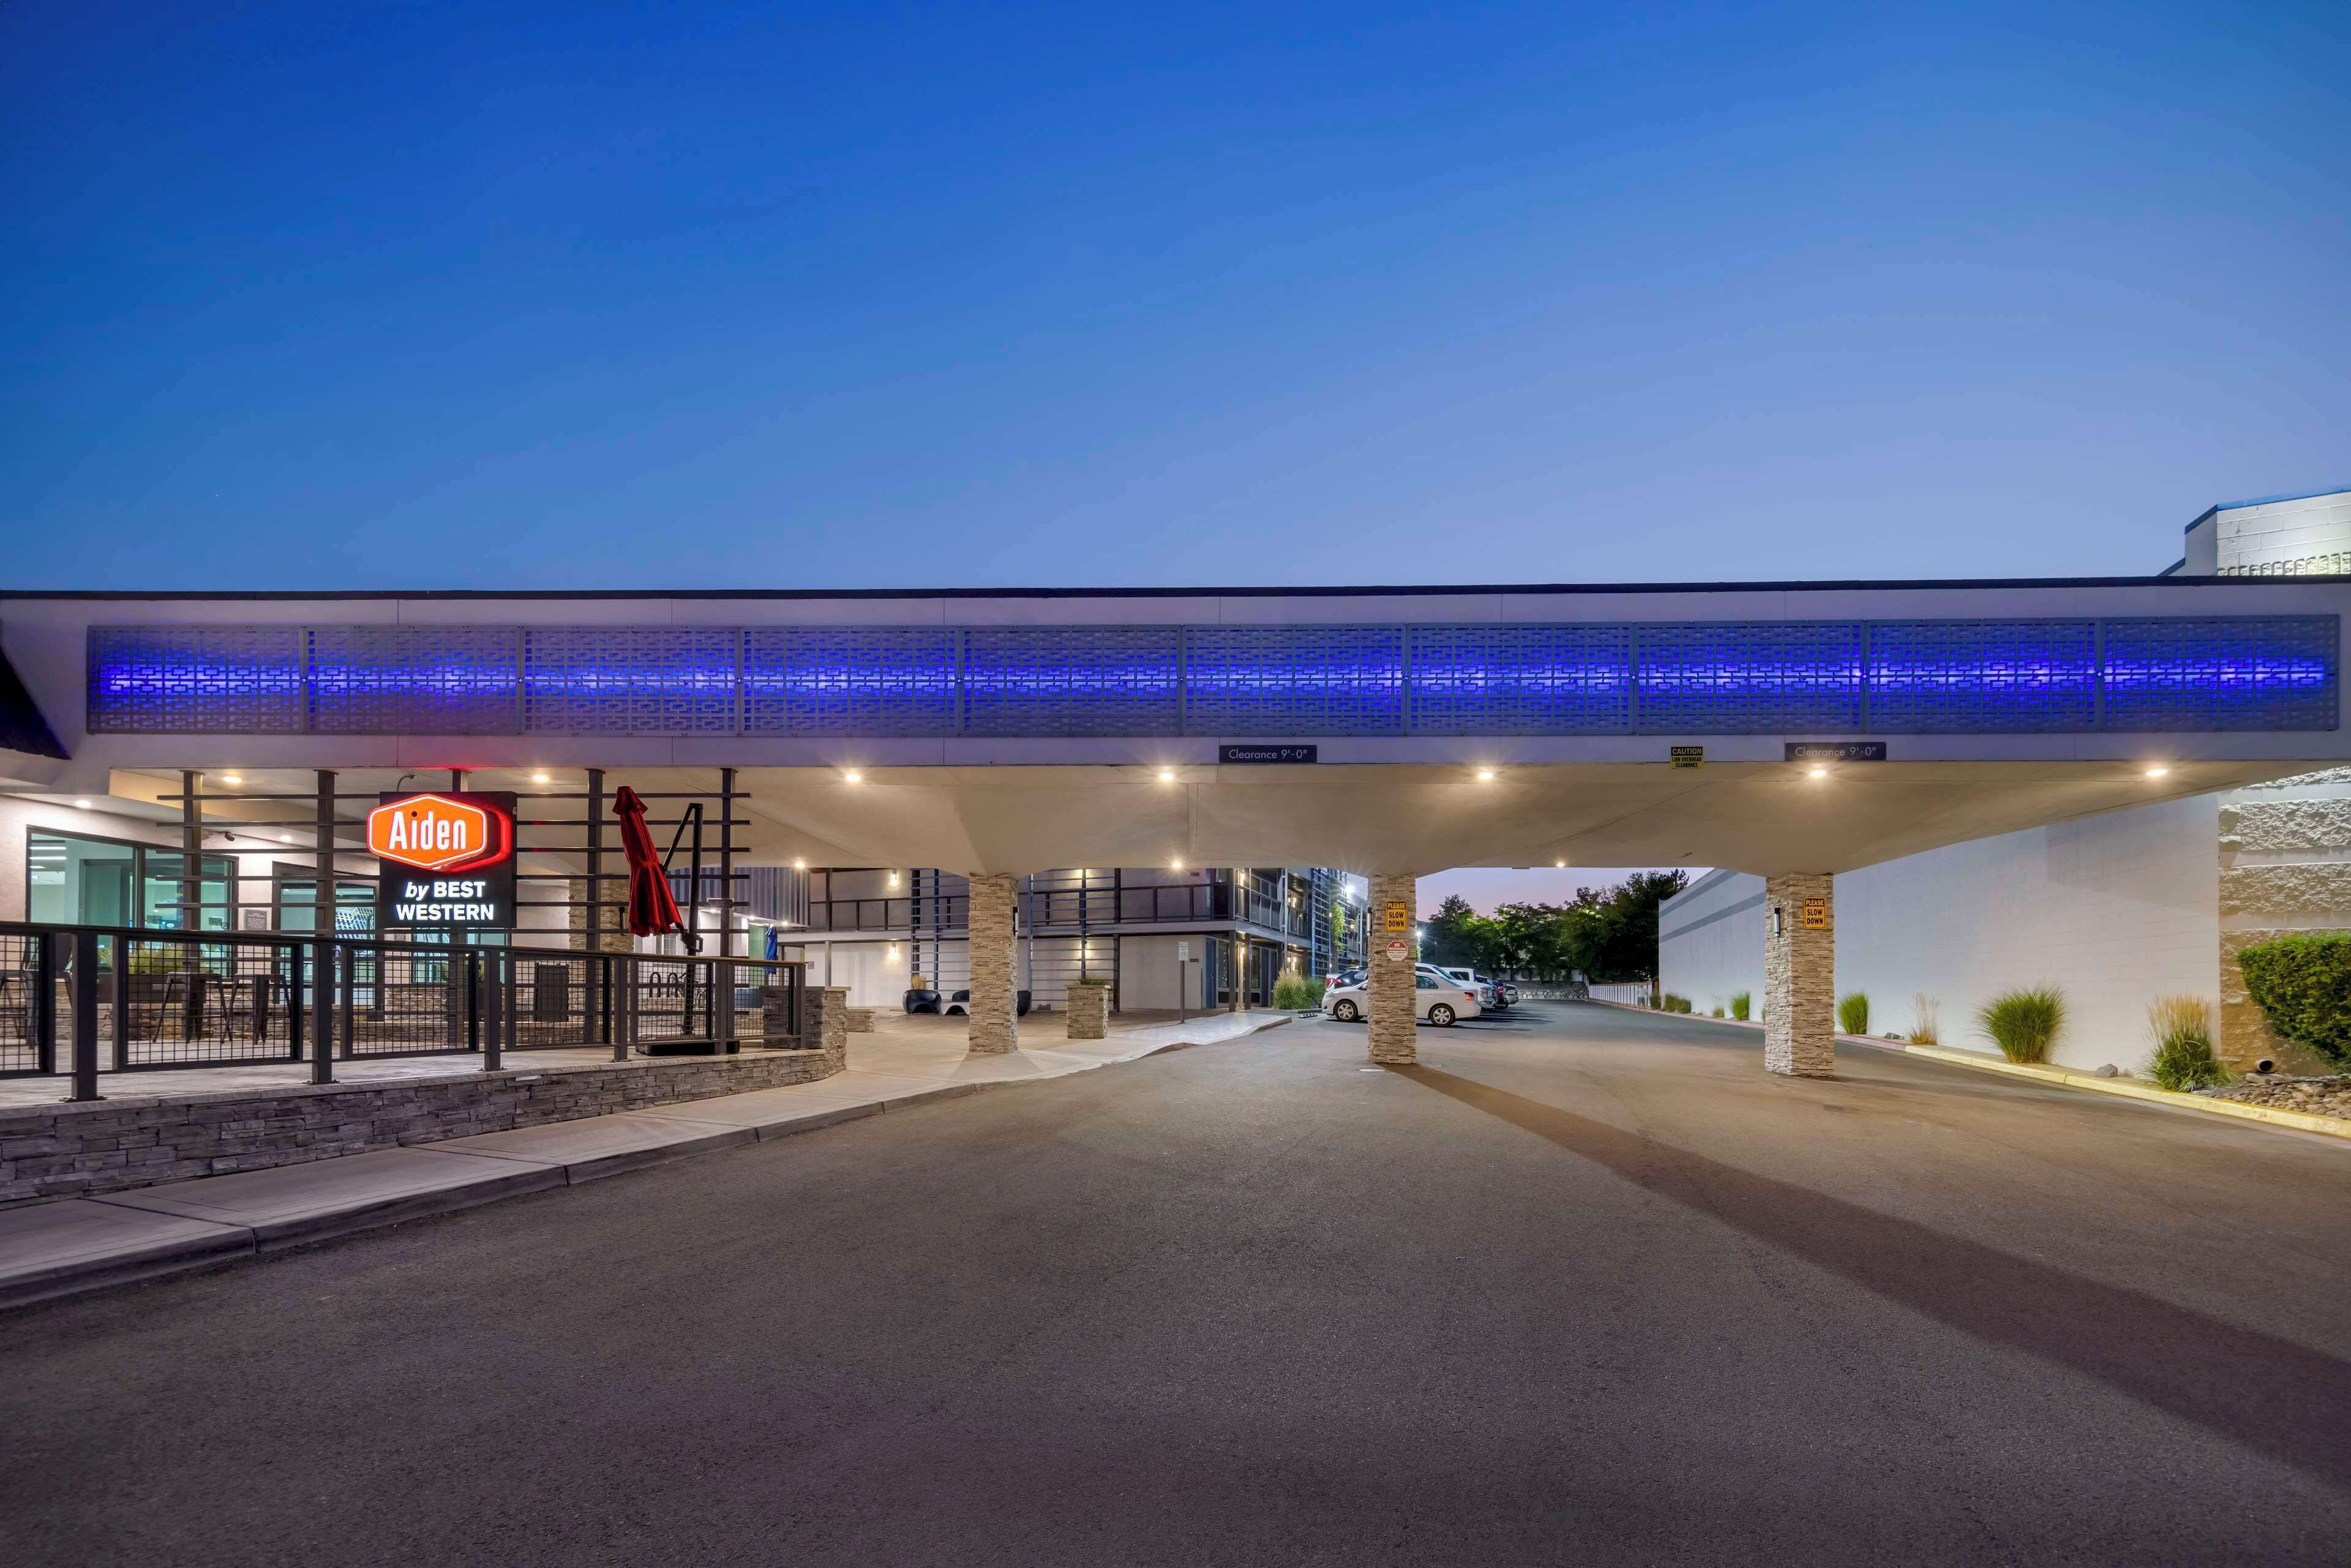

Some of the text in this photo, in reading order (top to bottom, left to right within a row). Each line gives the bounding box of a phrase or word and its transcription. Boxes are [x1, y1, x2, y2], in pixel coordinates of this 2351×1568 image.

[1229, 748, 1307, 759] Clearance 9'-0"
[1795, 746, 1876, 757] Clearance 9'-0"
[388, 811, 467, 850] Aiden
[405, 881, 486, 901] by BEST
[396, 904, 494, 921] WESTERN
